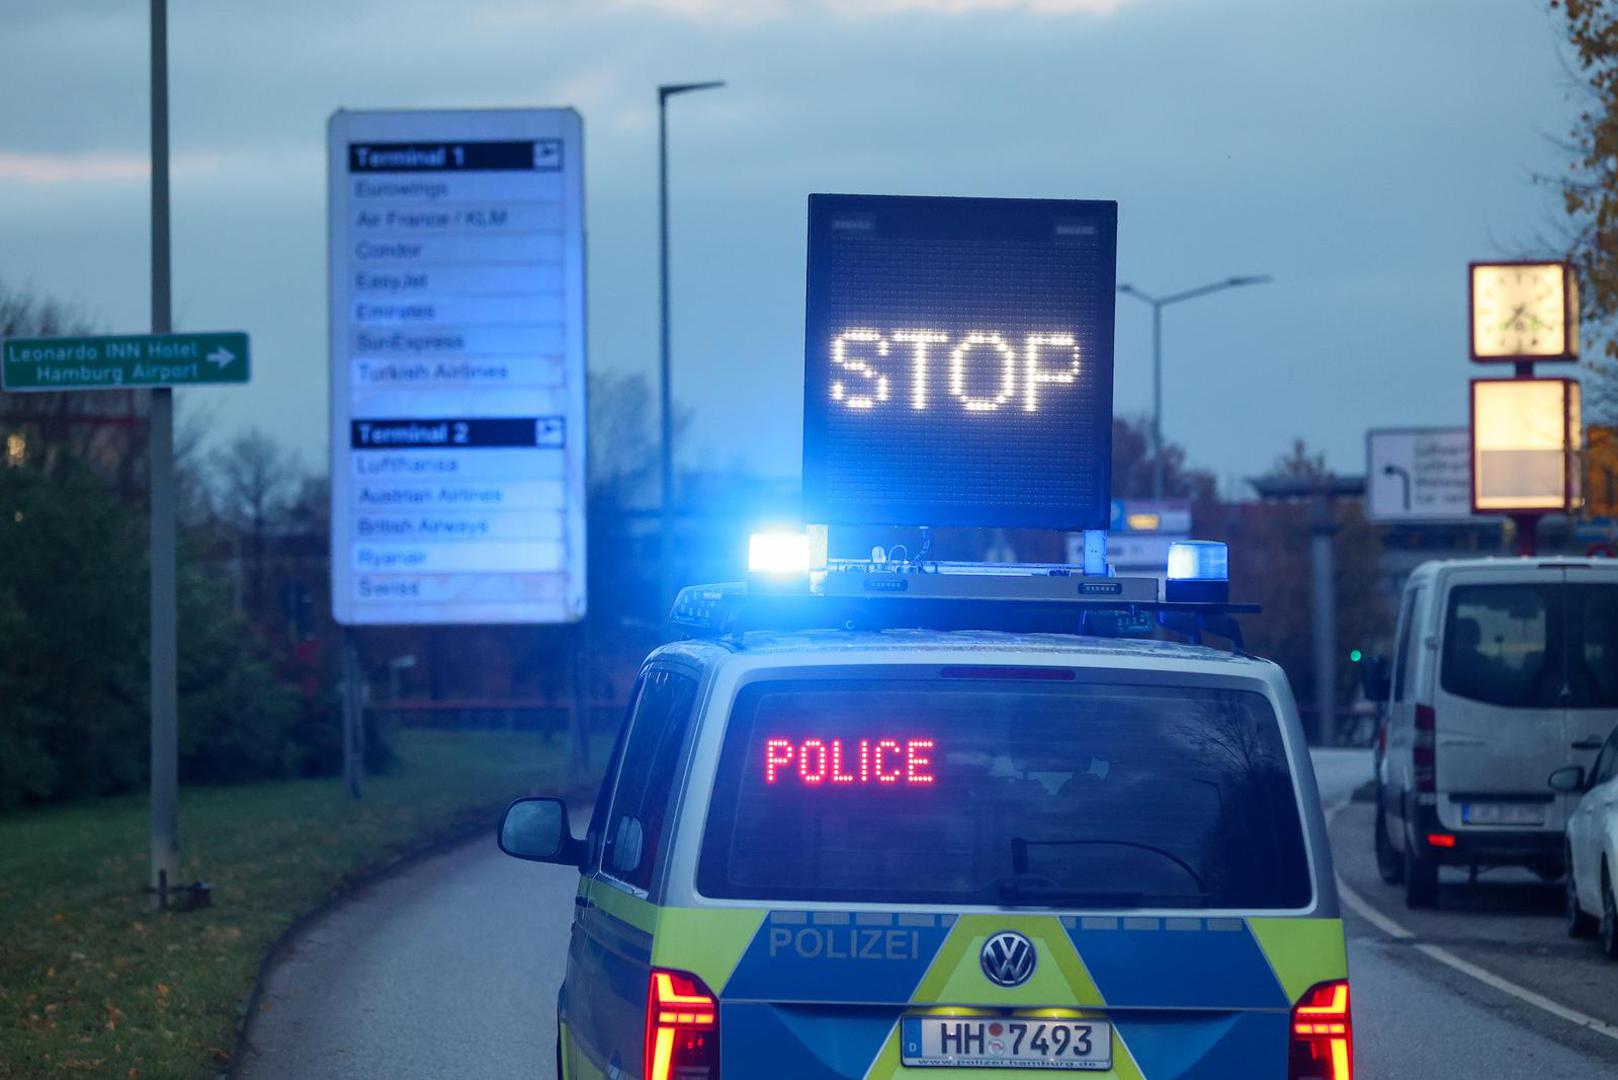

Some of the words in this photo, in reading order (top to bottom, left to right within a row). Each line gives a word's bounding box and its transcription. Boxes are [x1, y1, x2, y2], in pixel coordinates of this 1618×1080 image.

[356, 146, 446, 167] Terminal
[452, 146, 465, 167] 1
[354, 180, 448, 200] Eurowings
[386, 210, 449, 226] France
[465, 209, 508, 227] KLM
[355, 241, 422, 258] Condor
[356, 303, 435, 320] Emirates
[9, 344, 98, 362] Leonardo
[105, 342, 141, 359] INN
[148, 340, 198, 358] Hotel
[36, 365, 124, 385] Hamburg
[132, 363, 199, 381] Airport
[359, 363, 429, 379] Turkish
[434, 363, 508, 379] Airlines
[830, 327, 1081, 413] STOP
[358, 423, 448, 444] Terminal
[454, 422, 470, 444] 2
[357, 457, 459, 475] Lufthansa
[360, 487, 433, 504] Austrian
[439, 487, 504, 504] Airlines
[357, 518, 415, 536] British
[418, 518, 489, 538] Airways
[767, 739, 935, 783] POLICE
[769, 927, 919, 960] POLIZEI
[941, 1022, 985, 1054] HH
[1008, 1023, 1093, 1057] 7493
[918, 1058, 1098, 1068] www.polizei.hamburg.de
